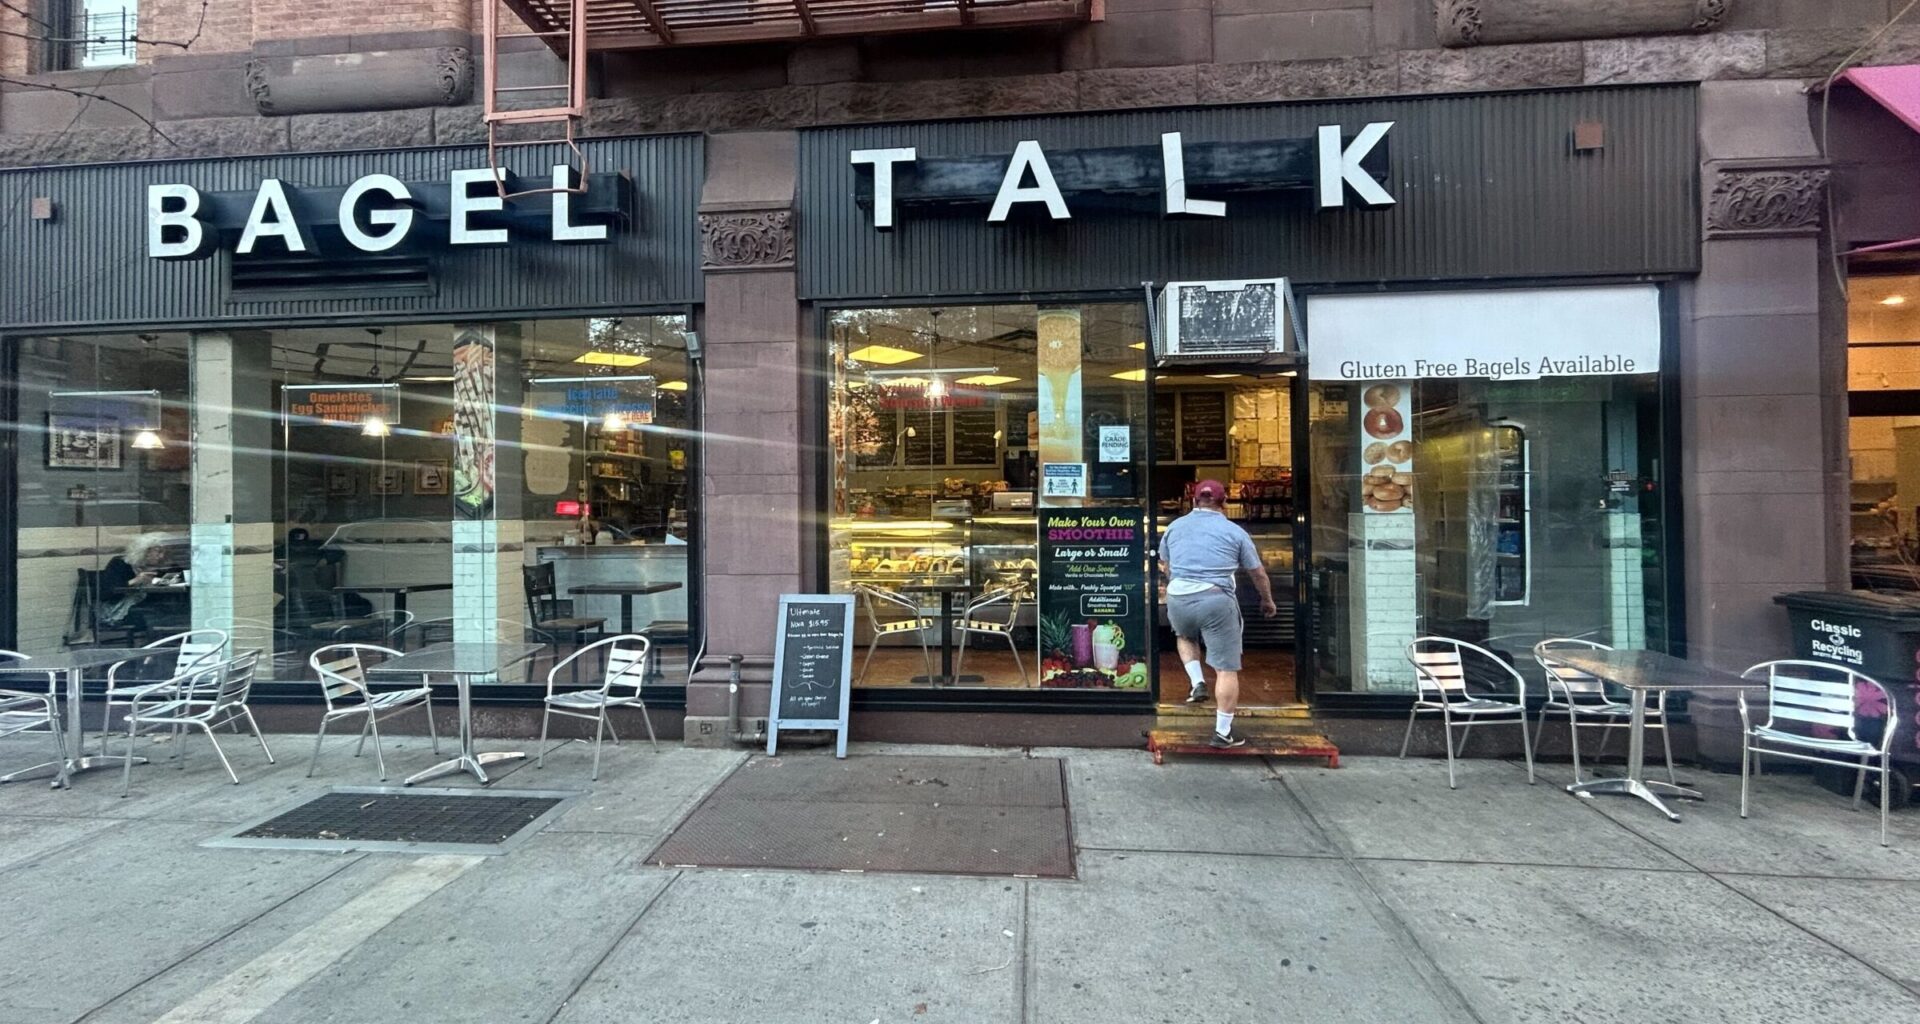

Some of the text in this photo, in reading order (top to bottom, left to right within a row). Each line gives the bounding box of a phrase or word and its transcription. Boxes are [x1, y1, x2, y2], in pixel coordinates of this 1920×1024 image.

[850, 121, 1397, 229] TALK
[148, 164, 608, 258] BAGEL
[1340, 354, 1635, 380] Gluten Free Bagels Available
[309, 392, 373, 403] Omelettes
[291, 403, 313, 415] Egg
[1047, 516, 1136, 528] Make Your Own
[1048, 528, 1134, 541] SMOOTHIE
[1055, 547, 1129, 562] Large or Small
[1811, 619, 1862, 638] Classic
[1812, 639, 1863, 661] Recycling
